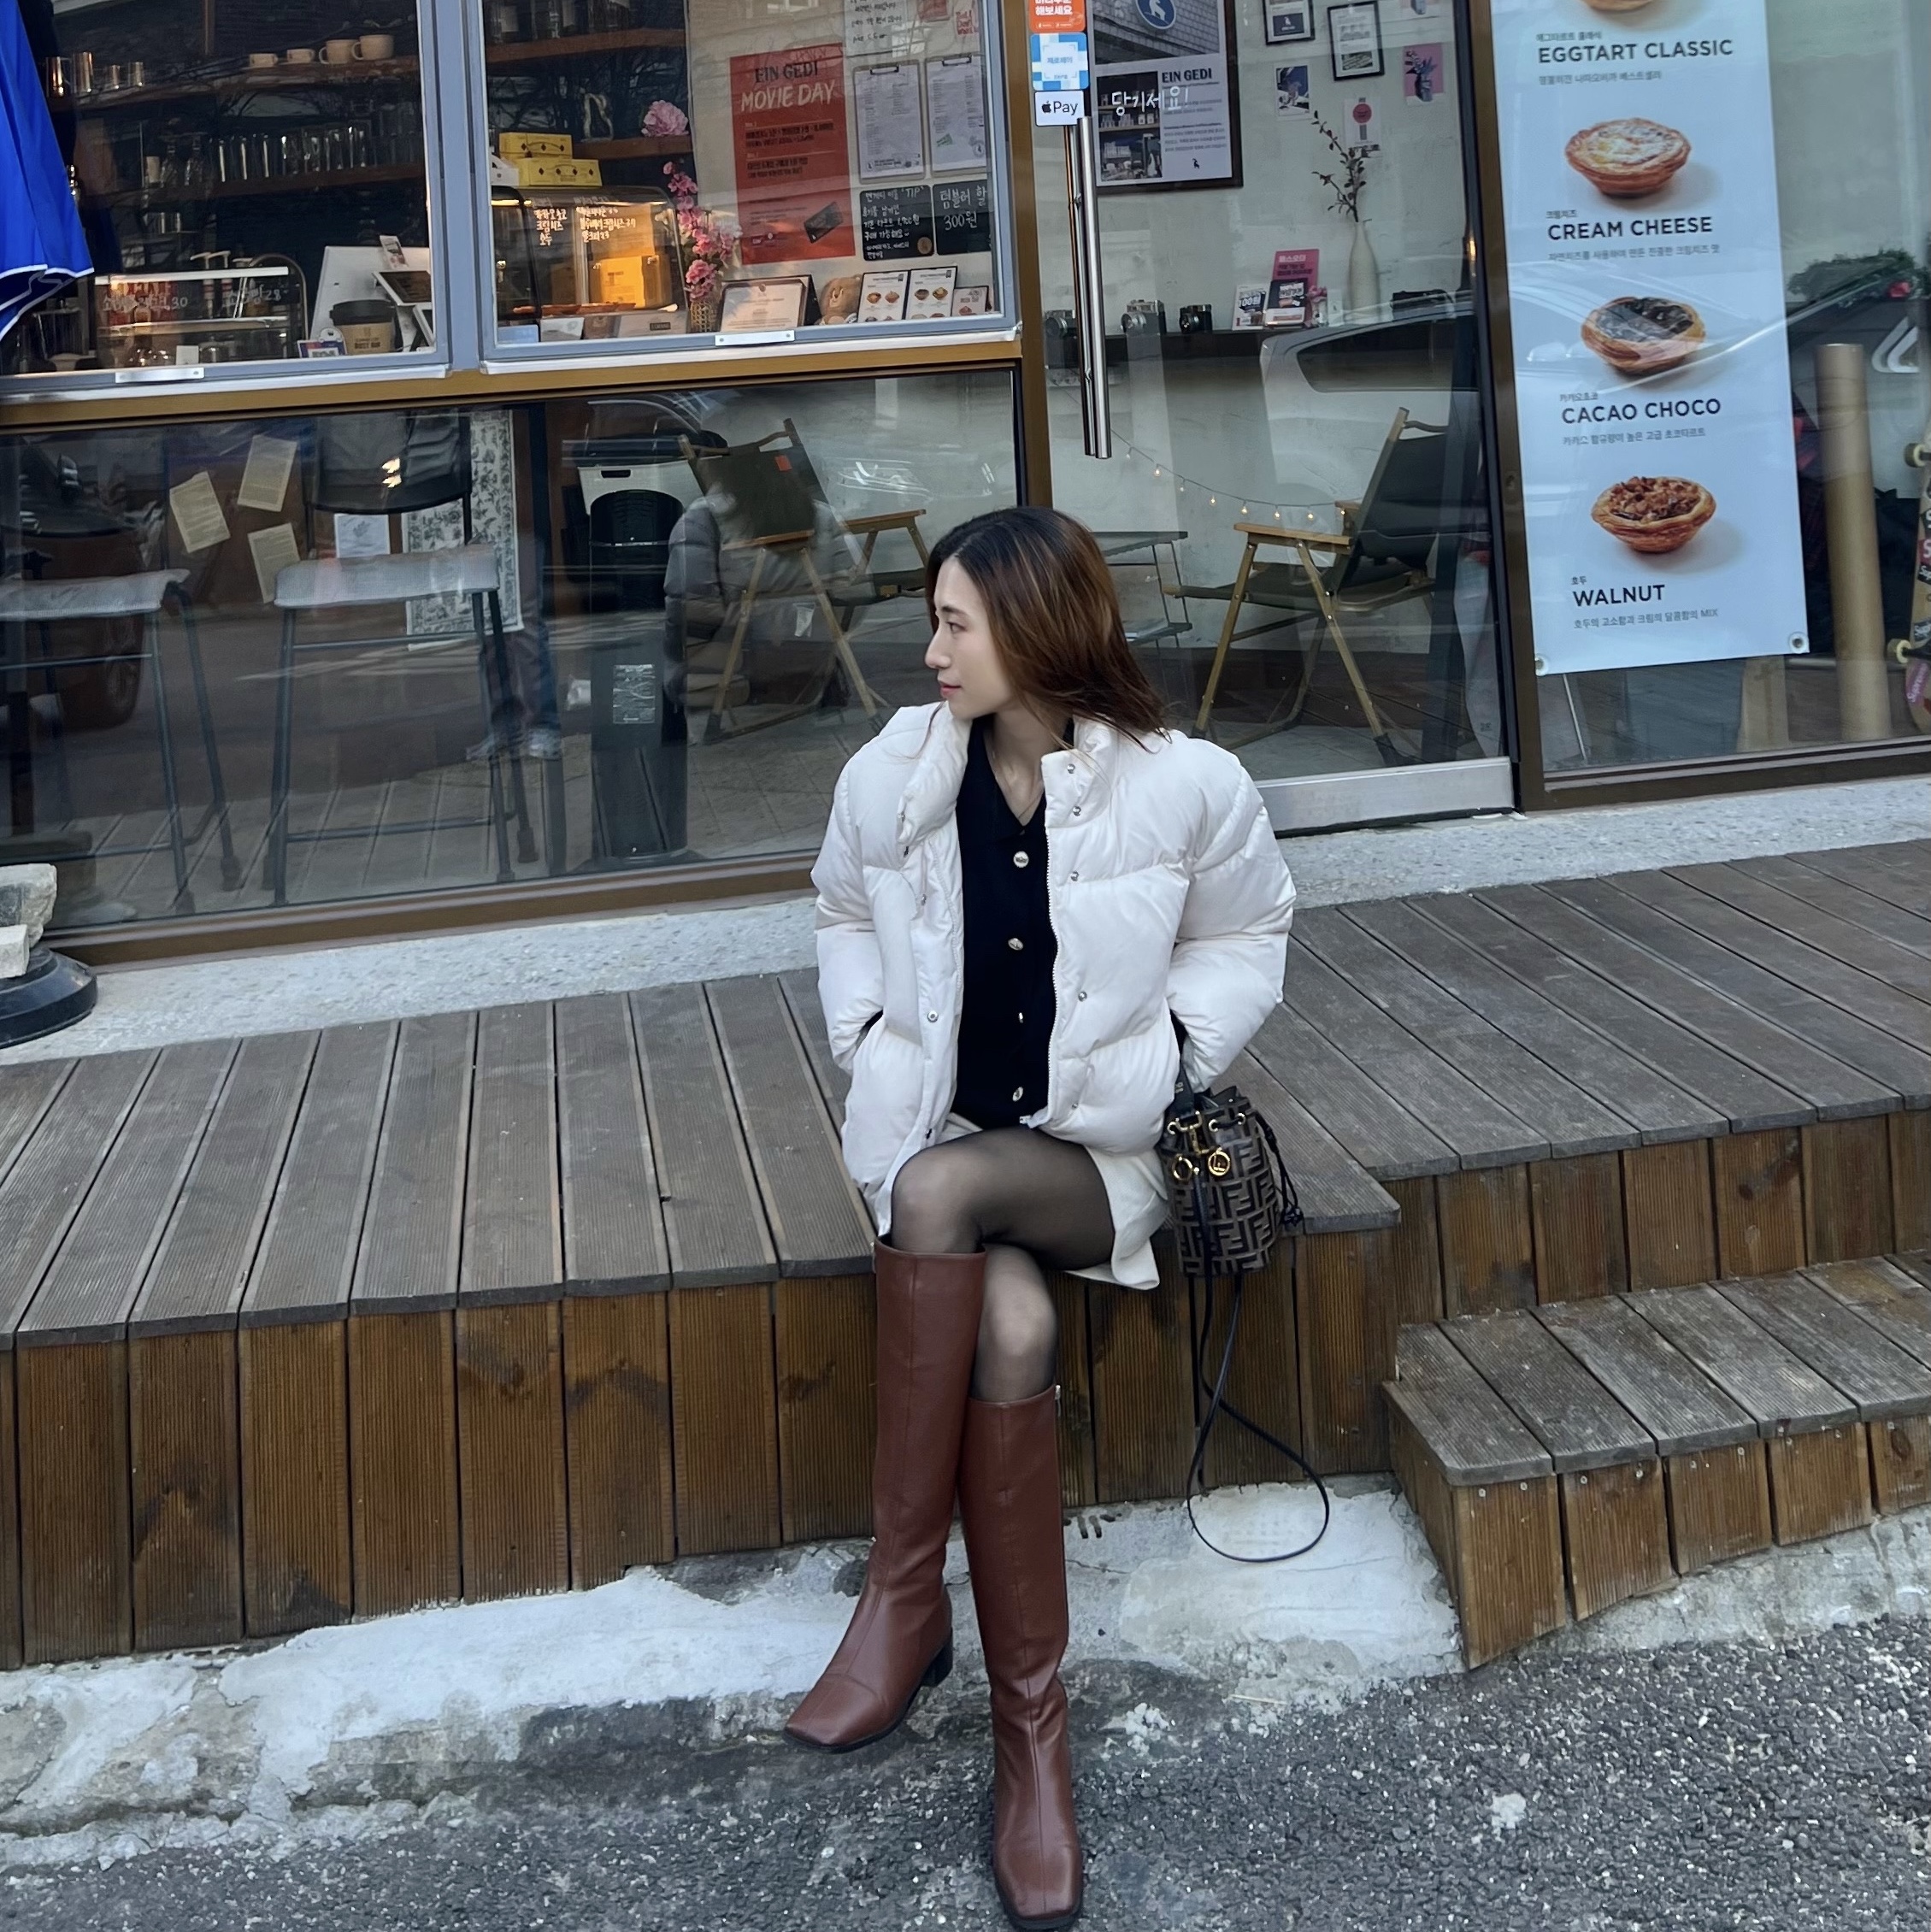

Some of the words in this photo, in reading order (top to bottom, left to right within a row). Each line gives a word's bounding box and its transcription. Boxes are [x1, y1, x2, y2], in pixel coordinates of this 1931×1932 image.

[1538, 44, 1637, 63] EGGTART
[1644, 38, 1734, 59] CLASSIC
[755, 66, 779, 83] EIN
[783, 60, 818, 80] GEDI
[1162, 71, 1182, 84] EIN
[1183, 68, 1212, 81] GEDI
[741, 85, 793, 112] MOVIE
[798, 80, 836, 106] DAY
[1053, 101, 1079, 115] Pay
[940, 188, 971, 209] 텀블러
[943, 210, 978, 231] 300원
[1548, 221, 1623, 240] CREAM
[1630, 216, 1713, 236] CHEESE
[1562, 403, 1638, 424] CACAO
[1645, 398, 1721, 418] CHOCO
[1571, 575, 1587, 586] 호두
[1573, 584, 1666, 607] WALNUT
